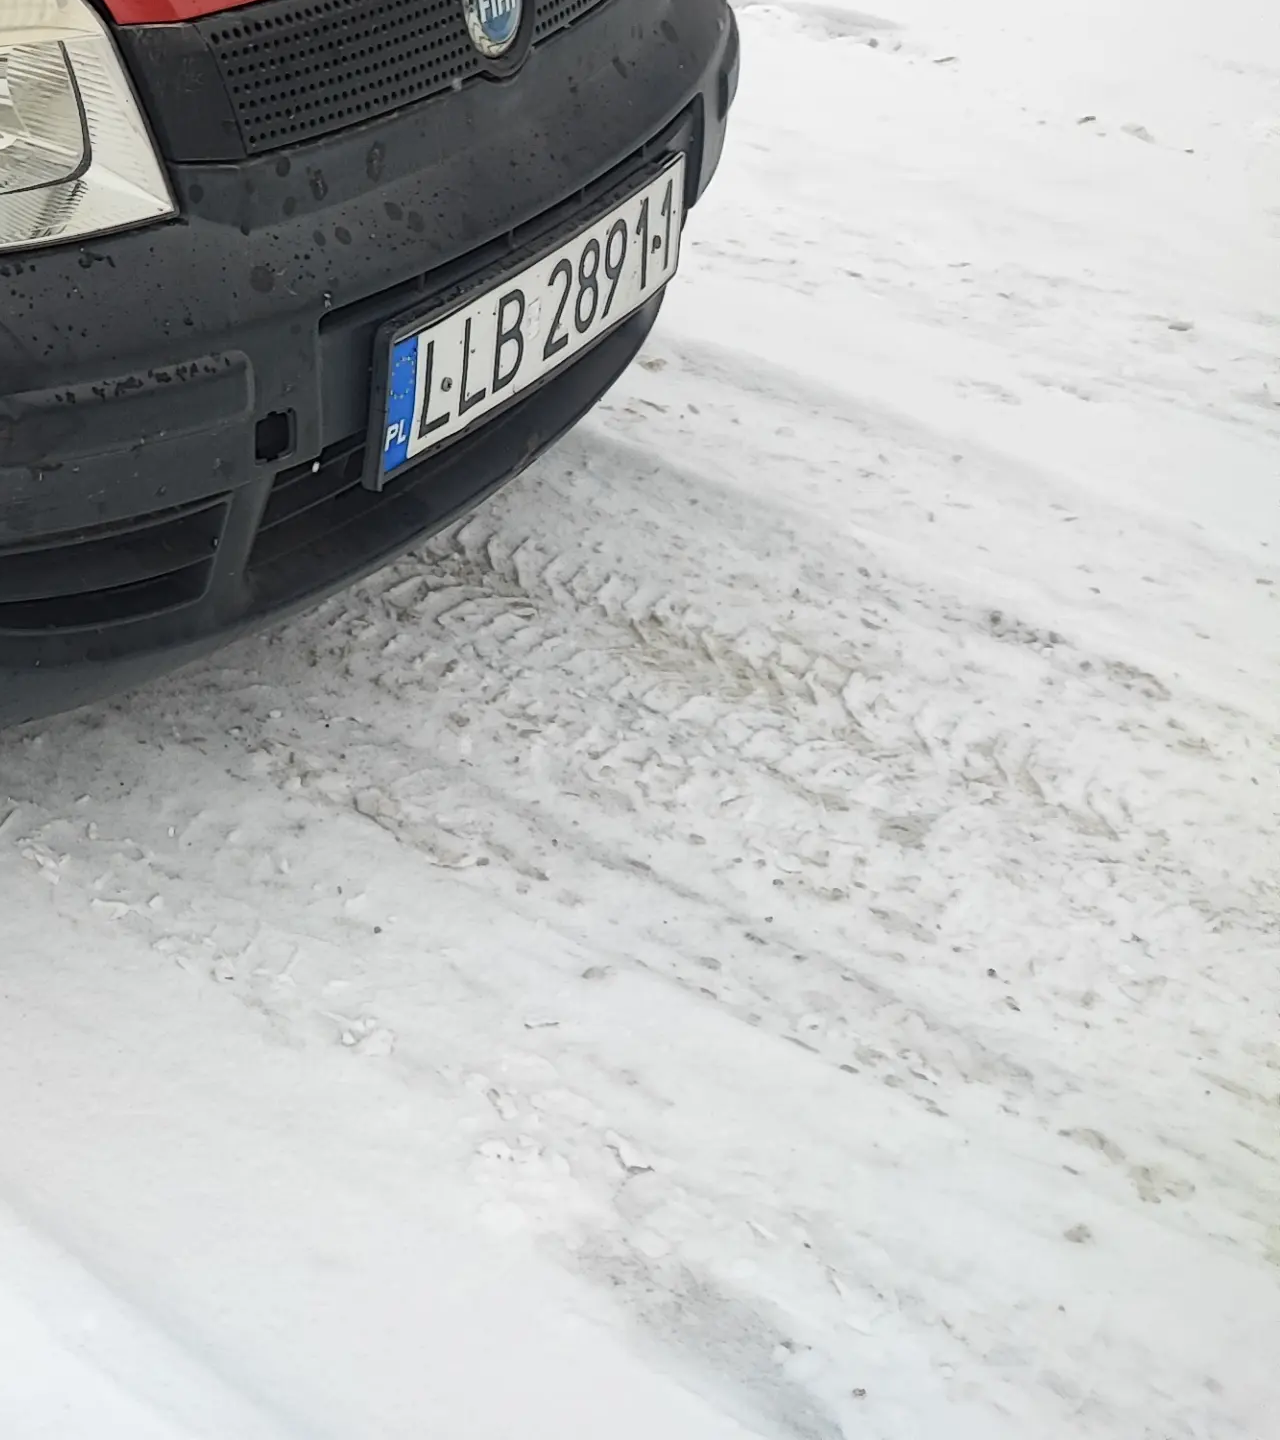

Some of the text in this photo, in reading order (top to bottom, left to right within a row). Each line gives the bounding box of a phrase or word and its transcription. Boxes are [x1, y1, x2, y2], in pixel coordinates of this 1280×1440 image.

[417, 177, 674, 440] LLB 28911
[384, 420, 407, 452] PL
